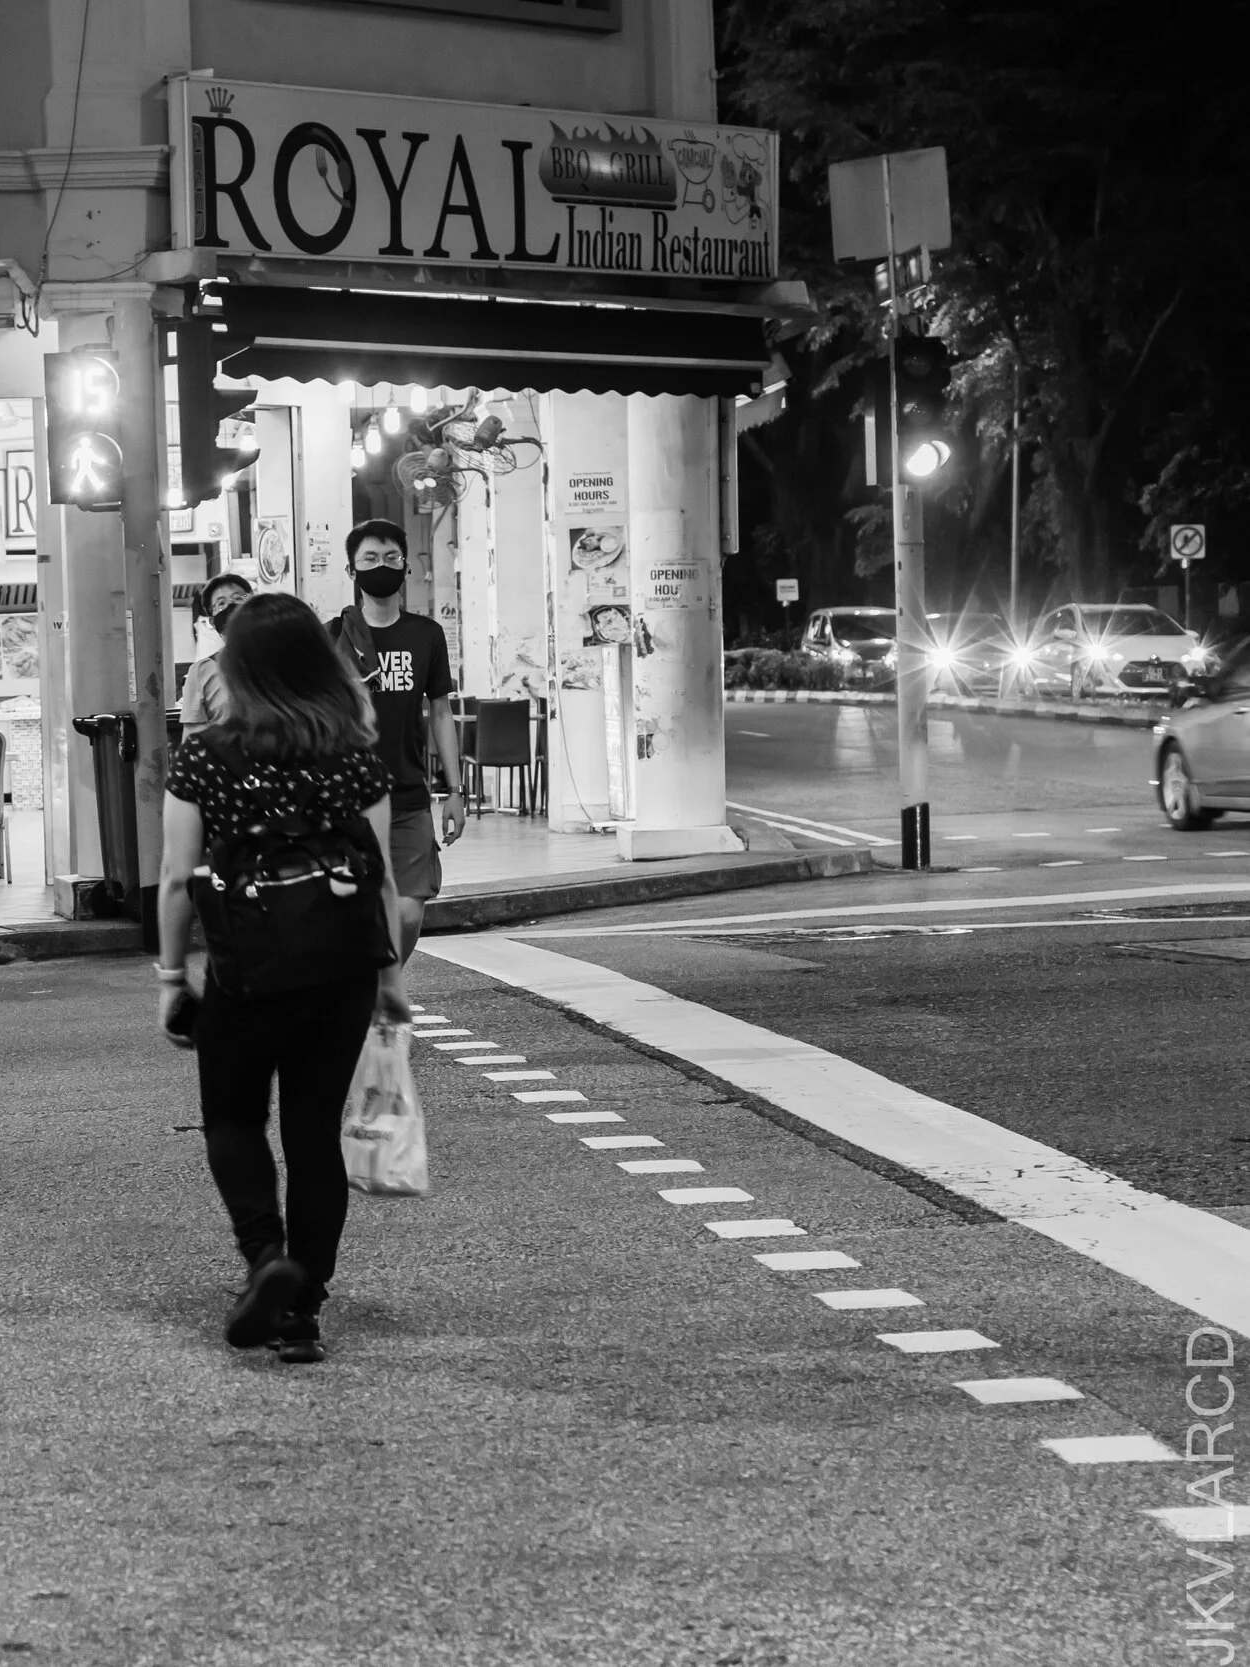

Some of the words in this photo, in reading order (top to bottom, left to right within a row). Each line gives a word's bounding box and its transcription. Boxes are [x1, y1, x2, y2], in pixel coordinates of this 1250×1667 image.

[550, 146, 590, 192] BBQ
[611, 151, 669, 186] GRILL
[192, 115, 560, 264] ROYAL
[566, 205, 643, 272] Indian
[651, 210, 771, 278] Restaurant
[569, 477, 614, 488] OPENING
[574, 490, 610, 501] HOURS
[650, 569, 699, 581] OPENING
